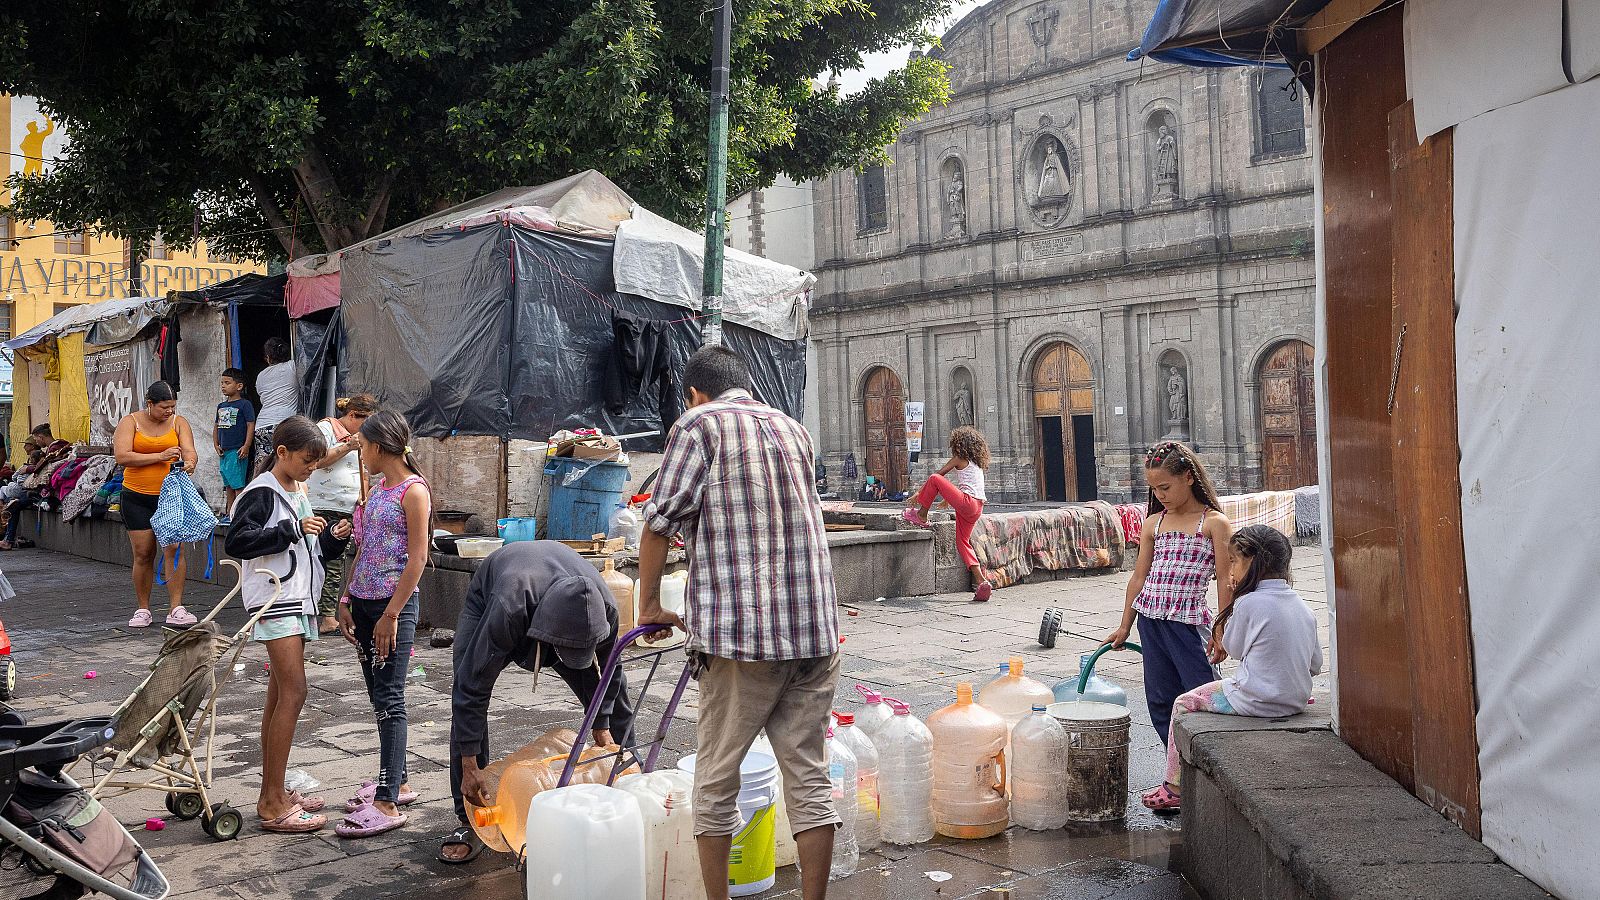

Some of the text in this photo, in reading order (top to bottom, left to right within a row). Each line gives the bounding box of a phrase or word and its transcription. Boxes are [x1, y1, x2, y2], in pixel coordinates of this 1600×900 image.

[34, 258, 57, 294] Y
[62, 259, 256, 298] FERRETE
[94, 380, 132, 428] 40%
